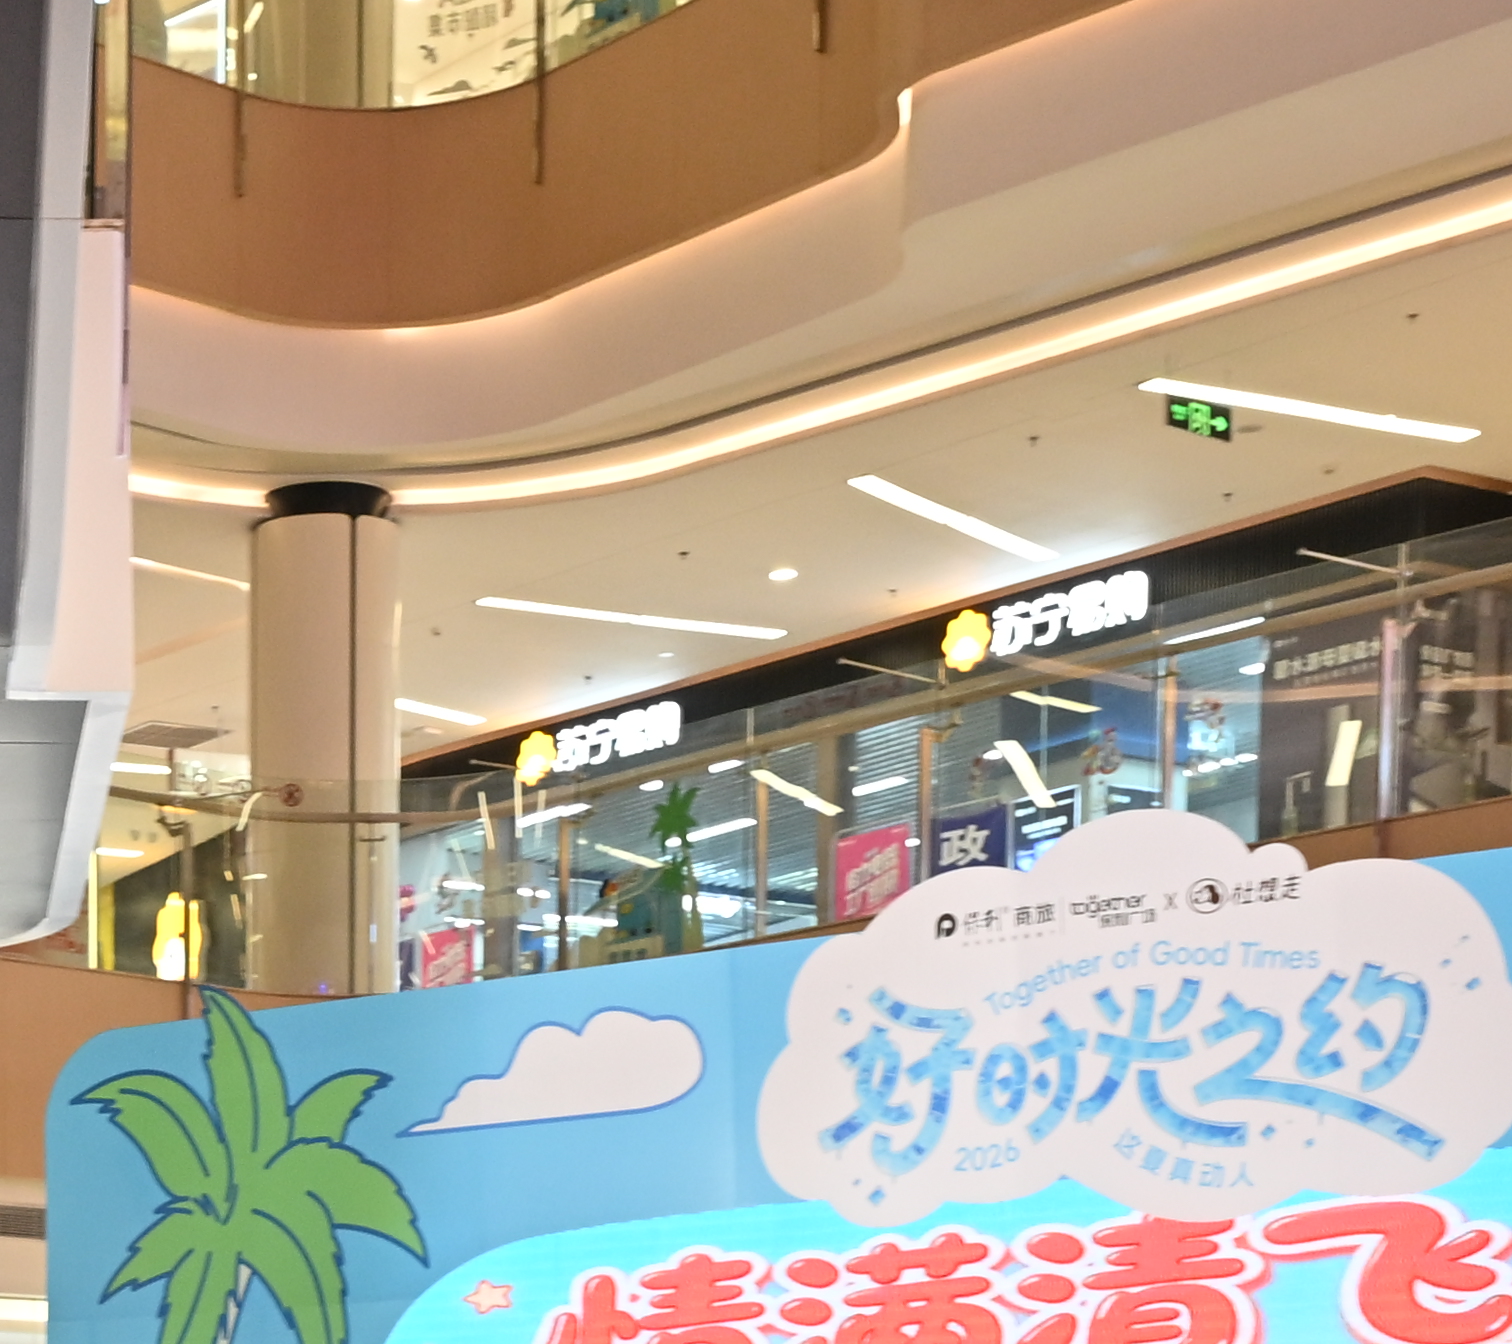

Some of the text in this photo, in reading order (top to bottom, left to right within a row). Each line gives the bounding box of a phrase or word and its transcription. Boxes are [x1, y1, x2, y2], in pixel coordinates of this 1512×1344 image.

[939, 824, 991, 867] 政
[983, 940, 1322, 1015] Together of Good Times
[818, 960, 1448, 1176] 好时光之约
[953, 1140, 1021, 1173] 2026
